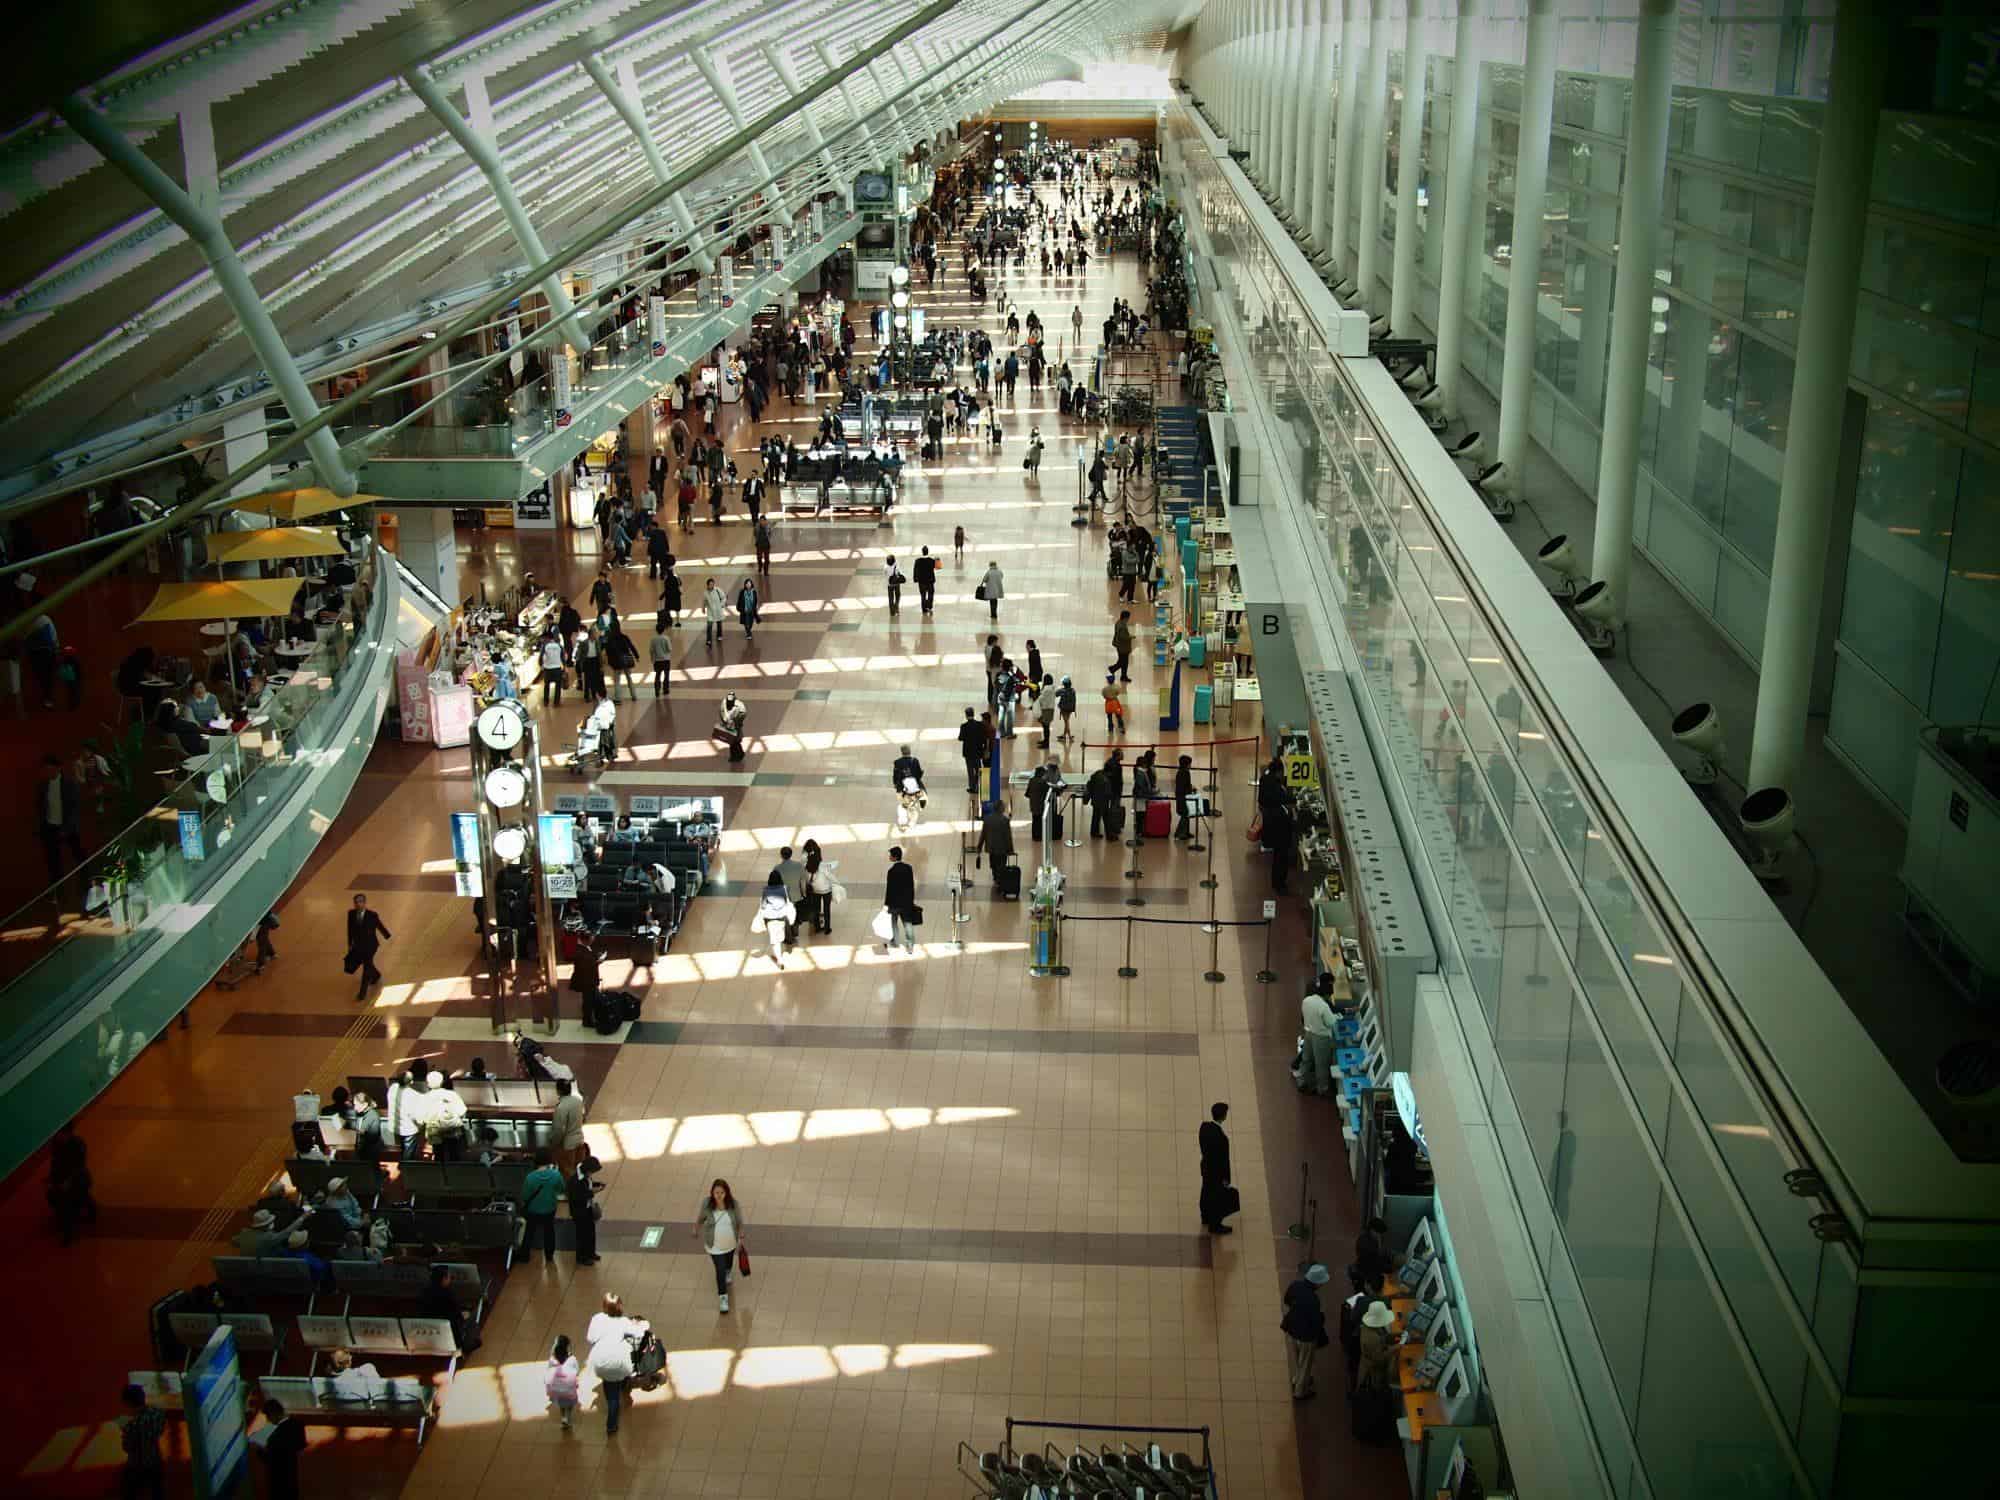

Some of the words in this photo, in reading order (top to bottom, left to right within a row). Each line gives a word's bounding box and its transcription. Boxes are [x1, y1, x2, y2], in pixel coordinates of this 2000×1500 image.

[1263, 614, 1280, 635] B
[491, 714, 509, 741] 4
[1292, 761, 1310, 780] 20
